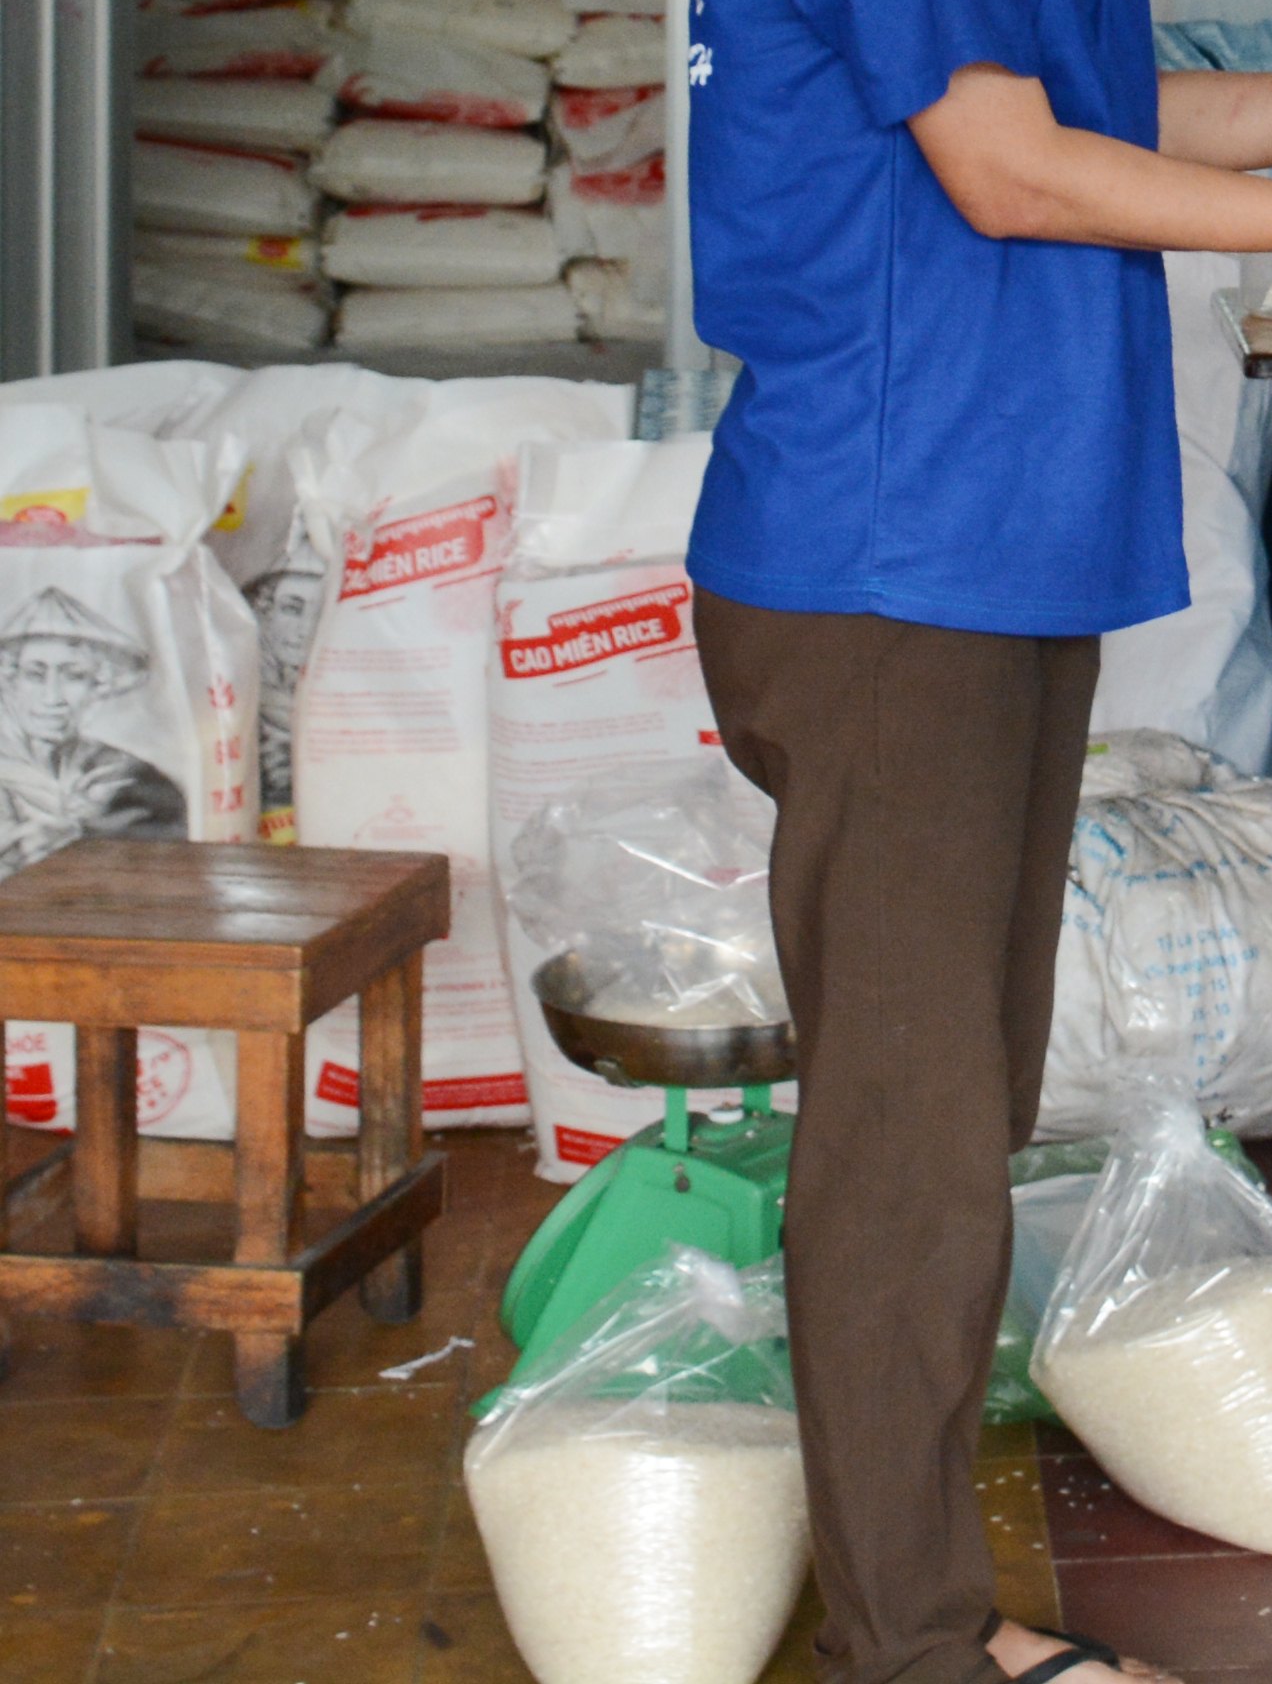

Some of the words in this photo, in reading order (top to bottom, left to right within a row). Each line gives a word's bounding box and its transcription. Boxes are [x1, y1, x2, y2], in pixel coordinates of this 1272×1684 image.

[414, 536, 468, 573] RICE
[509, 647, 553, 674] CAO
[611, 617, 667, 649] RICE
